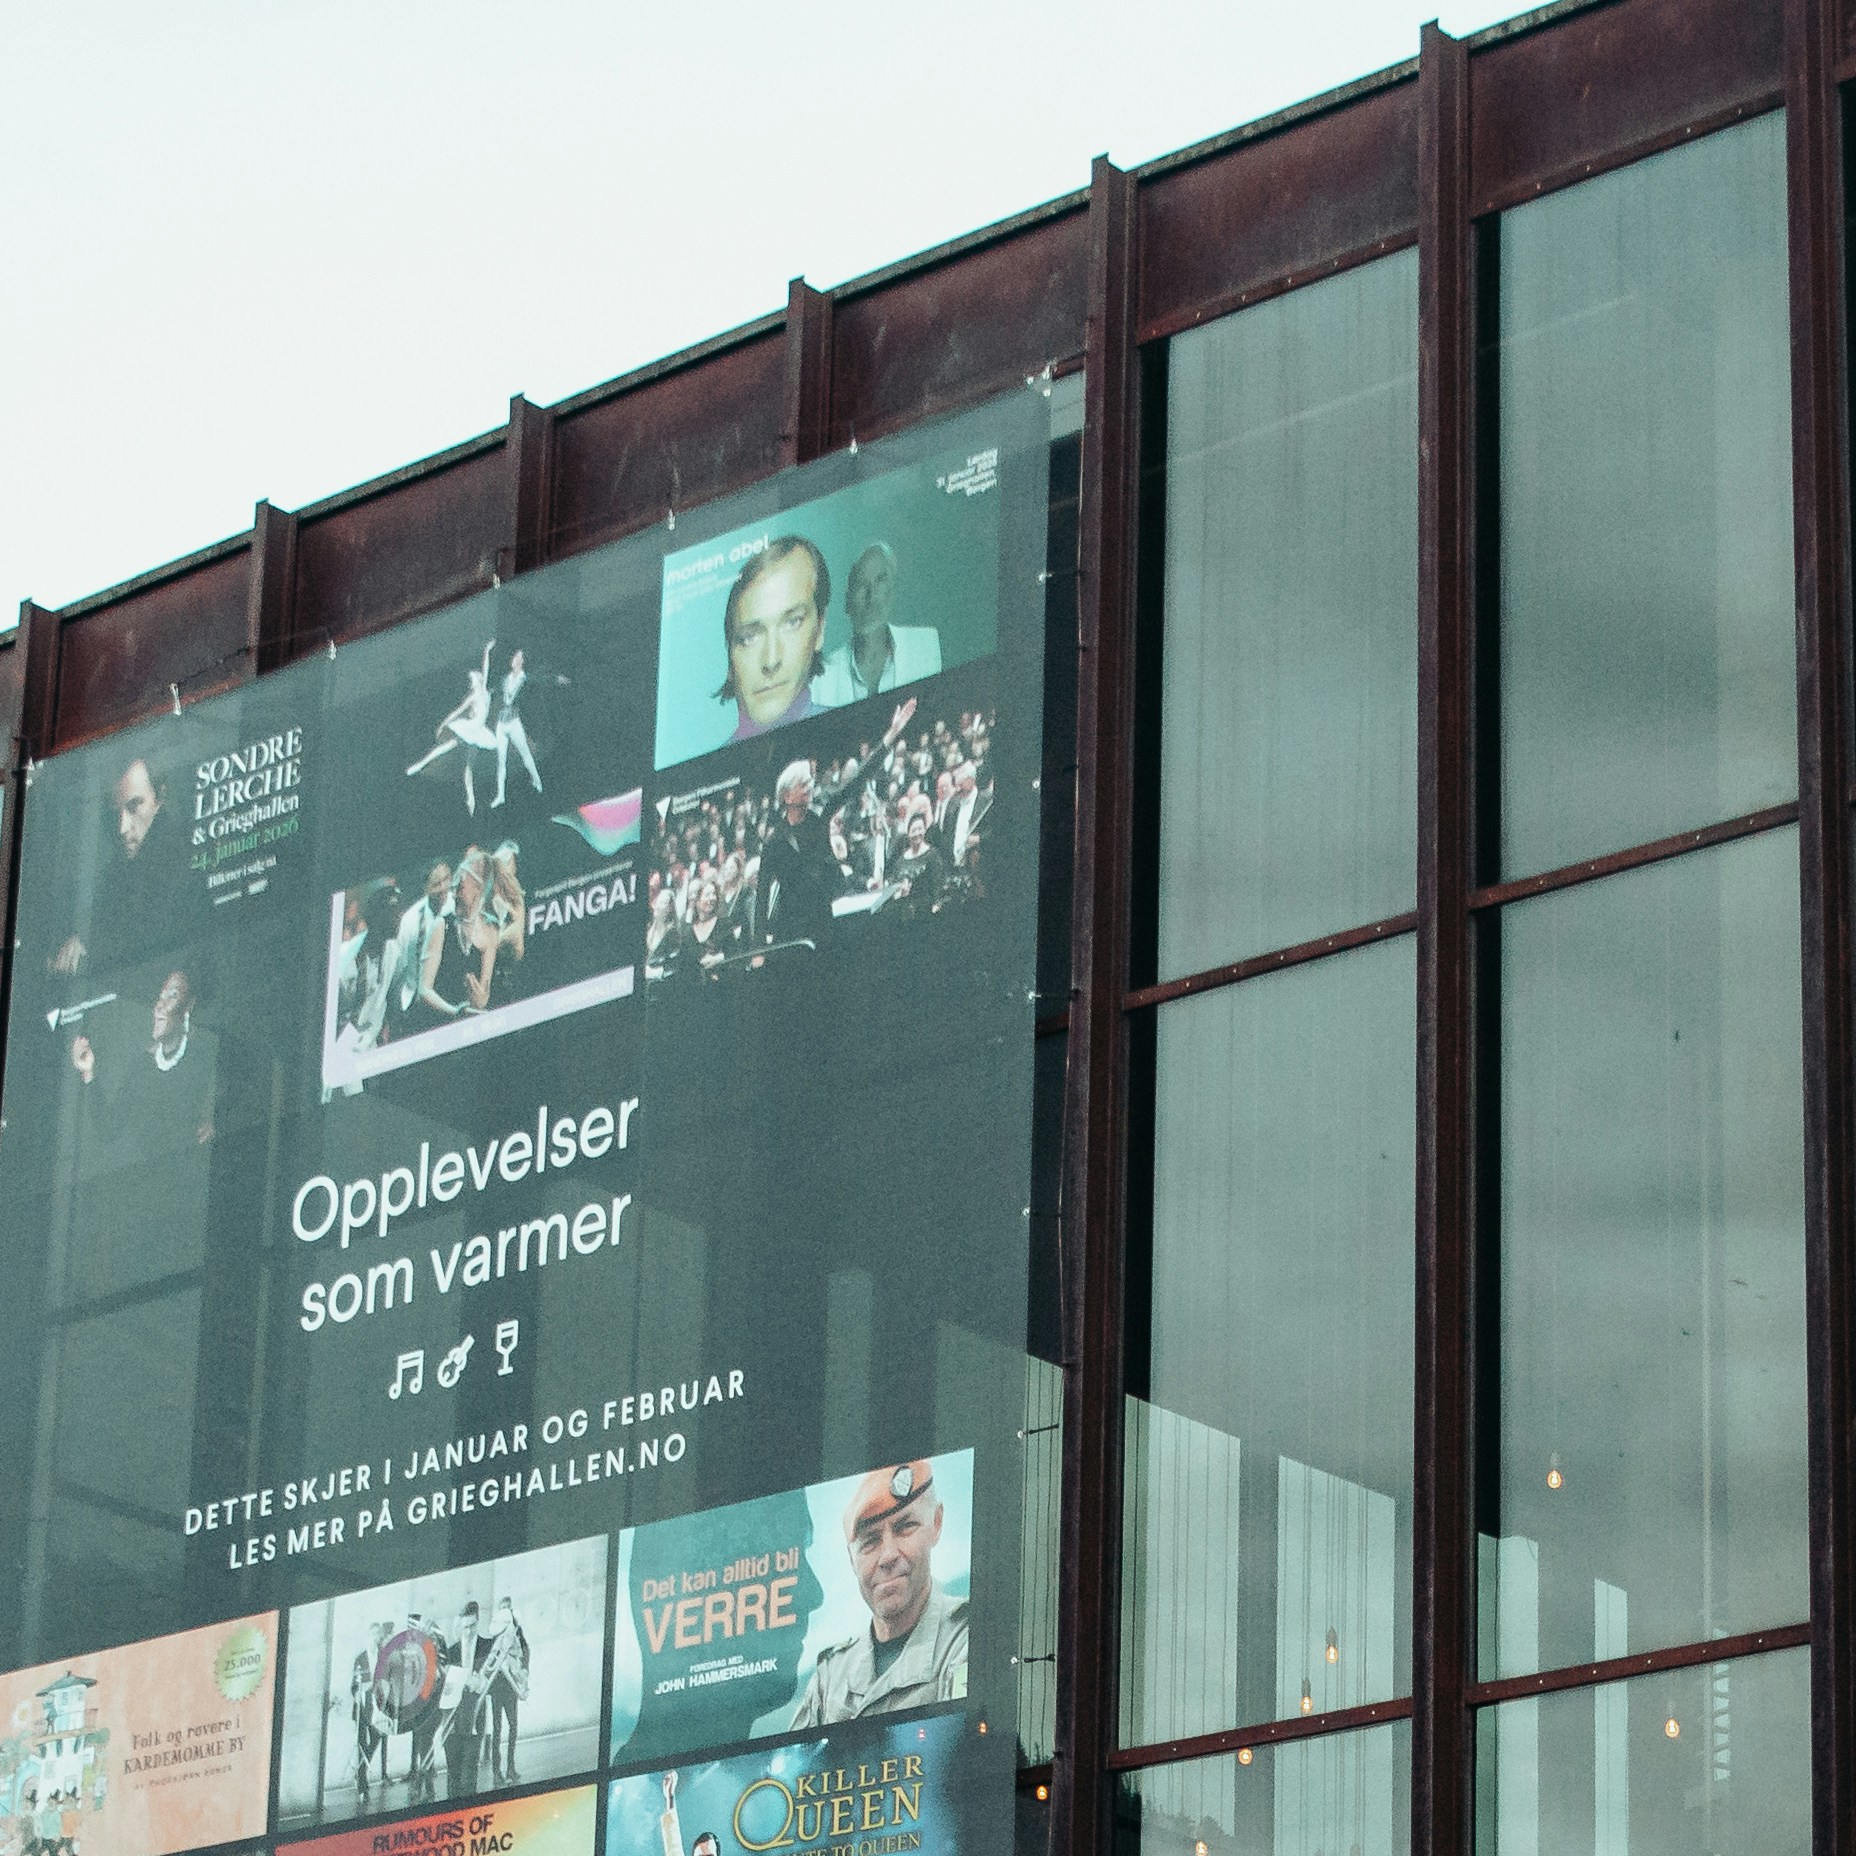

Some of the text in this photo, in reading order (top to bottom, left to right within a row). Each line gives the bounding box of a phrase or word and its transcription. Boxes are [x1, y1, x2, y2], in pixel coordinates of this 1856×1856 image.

[667, 534, 769, 585] morten abel
[196, 725, 302, 790] SONDRE
[195, 758, 301, 820] LERCHE
[192, 795, 299, 845] & Grieghallen
[528, 874, 637, 935] FANGA!
[293, 1098, 639, 1249] Opplevelser
[301, 1194, 632, 1332] som varmer
[184, 1369, 744, 1536] DETTE SKJER I JANUAR OG FEBRUAR
[230, 1433, 686, 1570] LES MER PÅ GRIEGHALLEN.NO
[643, 1546, 800, 1603] Det kan alltid bli
[643, 1576, 798, 1655] VERRE
[654, 1657, 779, 1696] JOHN HAMMERSMARK
[124, 1736, 247, 1775] KARDEMOMME BY
[132, 1731, 161, 1750] Folk
[167, 1731, 182, 1747] og
[796, 1755, 924, 1799] KILLER
[372, 1813, 495, 1855] RUMOURS OF
[733, 1778, 924, 1851] QUEEN
